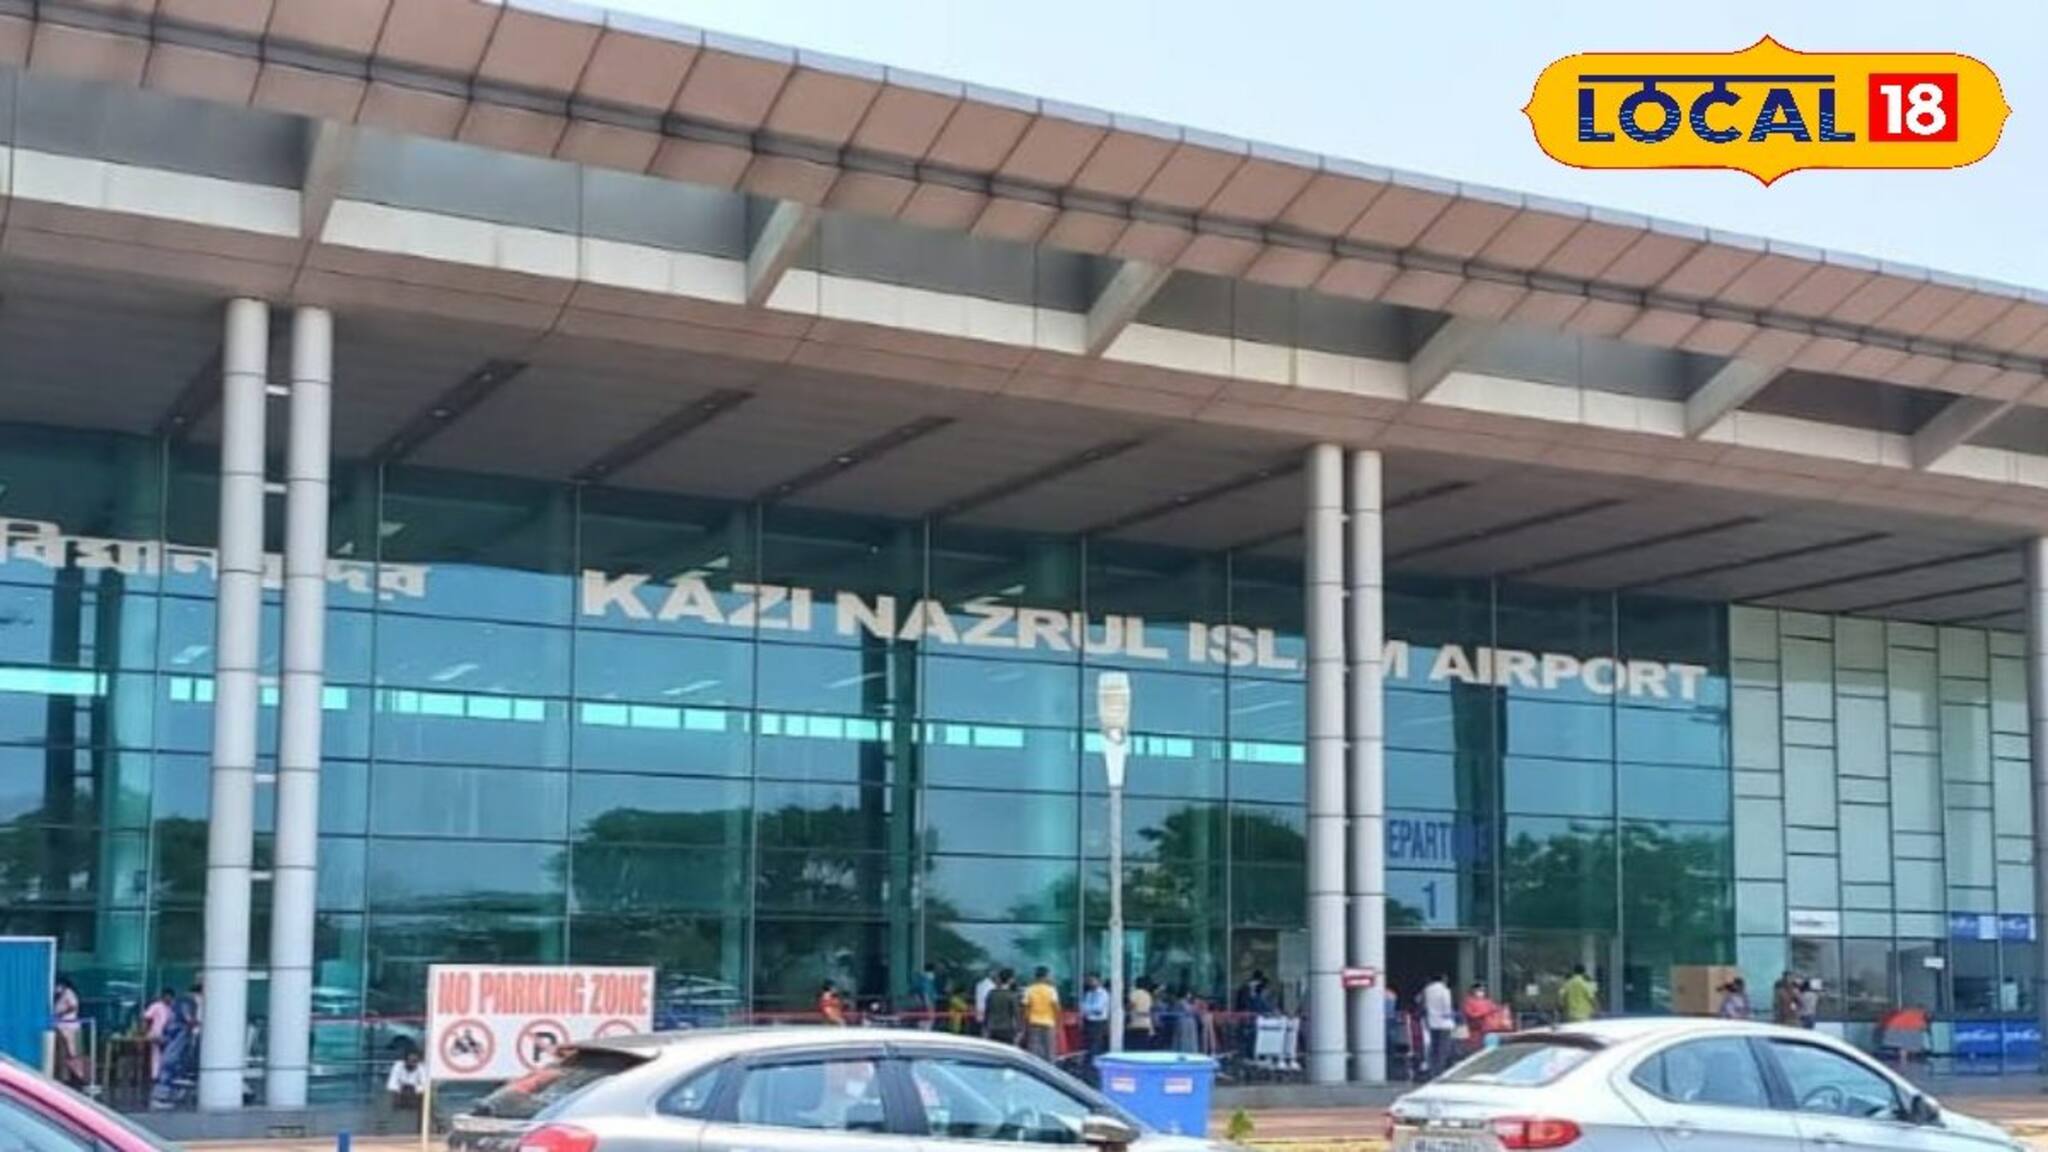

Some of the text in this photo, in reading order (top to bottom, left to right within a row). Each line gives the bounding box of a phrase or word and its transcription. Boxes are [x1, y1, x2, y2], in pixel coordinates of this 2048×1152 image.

[582, 569, 1708, 700] KAZI NAZRUL ISLM AIRPORT
[1422, 881, 1436, 919] 1
[437, 971, 648, 1016] NO PARKING ZONE
